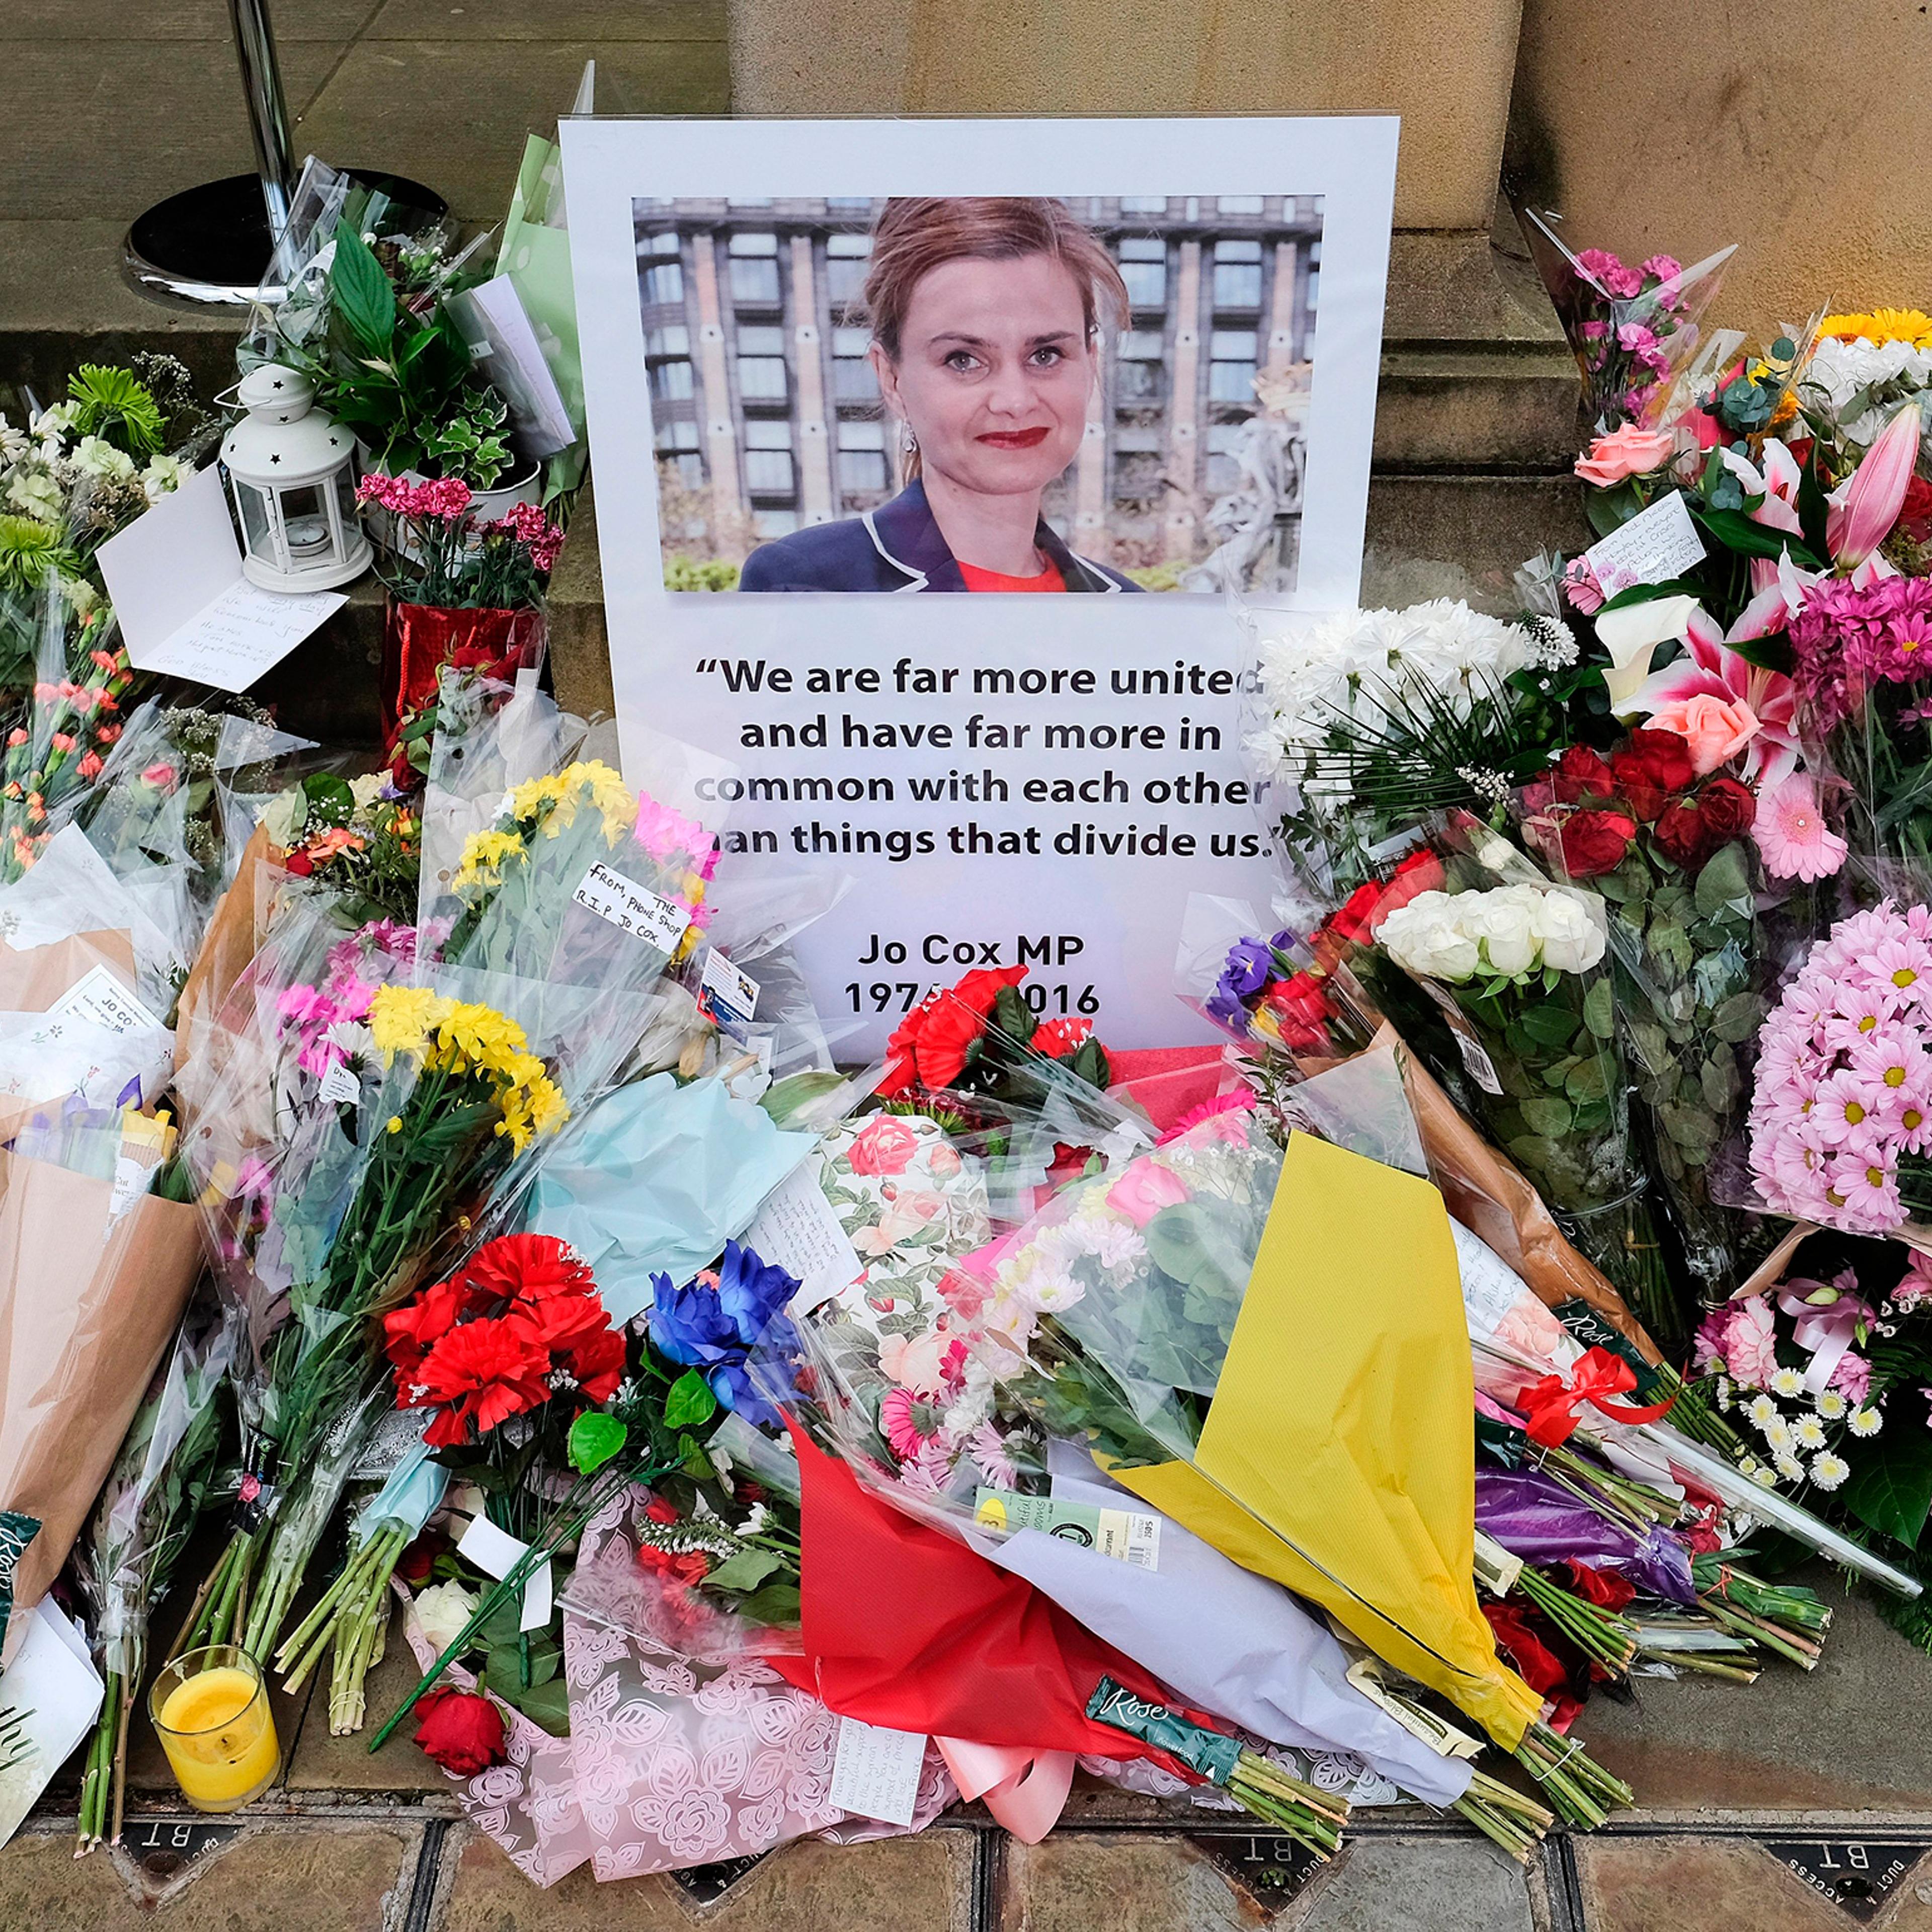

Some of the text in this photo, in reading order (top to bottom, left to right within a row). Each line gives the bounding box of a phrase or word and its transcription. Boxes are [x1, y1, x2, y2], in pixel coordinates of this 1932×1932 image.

[696, 658, 1265, 695] “We are far more united
[741, 714, 1221, 751] and have far more in
[694, 769, 1271, 805] common with each other
[791, 821, 935, 862] things
[947, 822, 1041, 855] that
[1053, 823, 1197, 856] divide
[627, 897, 656, 921] PHONE
[653, 896, 677, 917] THE
[857, 934, 1085, 966] Jo Cox MP
[102, 997, 137, 1027] JO CO
[1024, 984, 1100, 1014] 016
[1561, 1314, 1614, 1345] Rose
[1099, 1686, 1170, 1726] Rose
[141, 1823, 192, 1847] BT
[1243, 1837, 1293, 1862] BT
[1819, 1844, 1869, 1869] BT
[1788, 1858, 1845, 1904] ACCESS
[1876, 1859, 1906, 1892] DUCT
